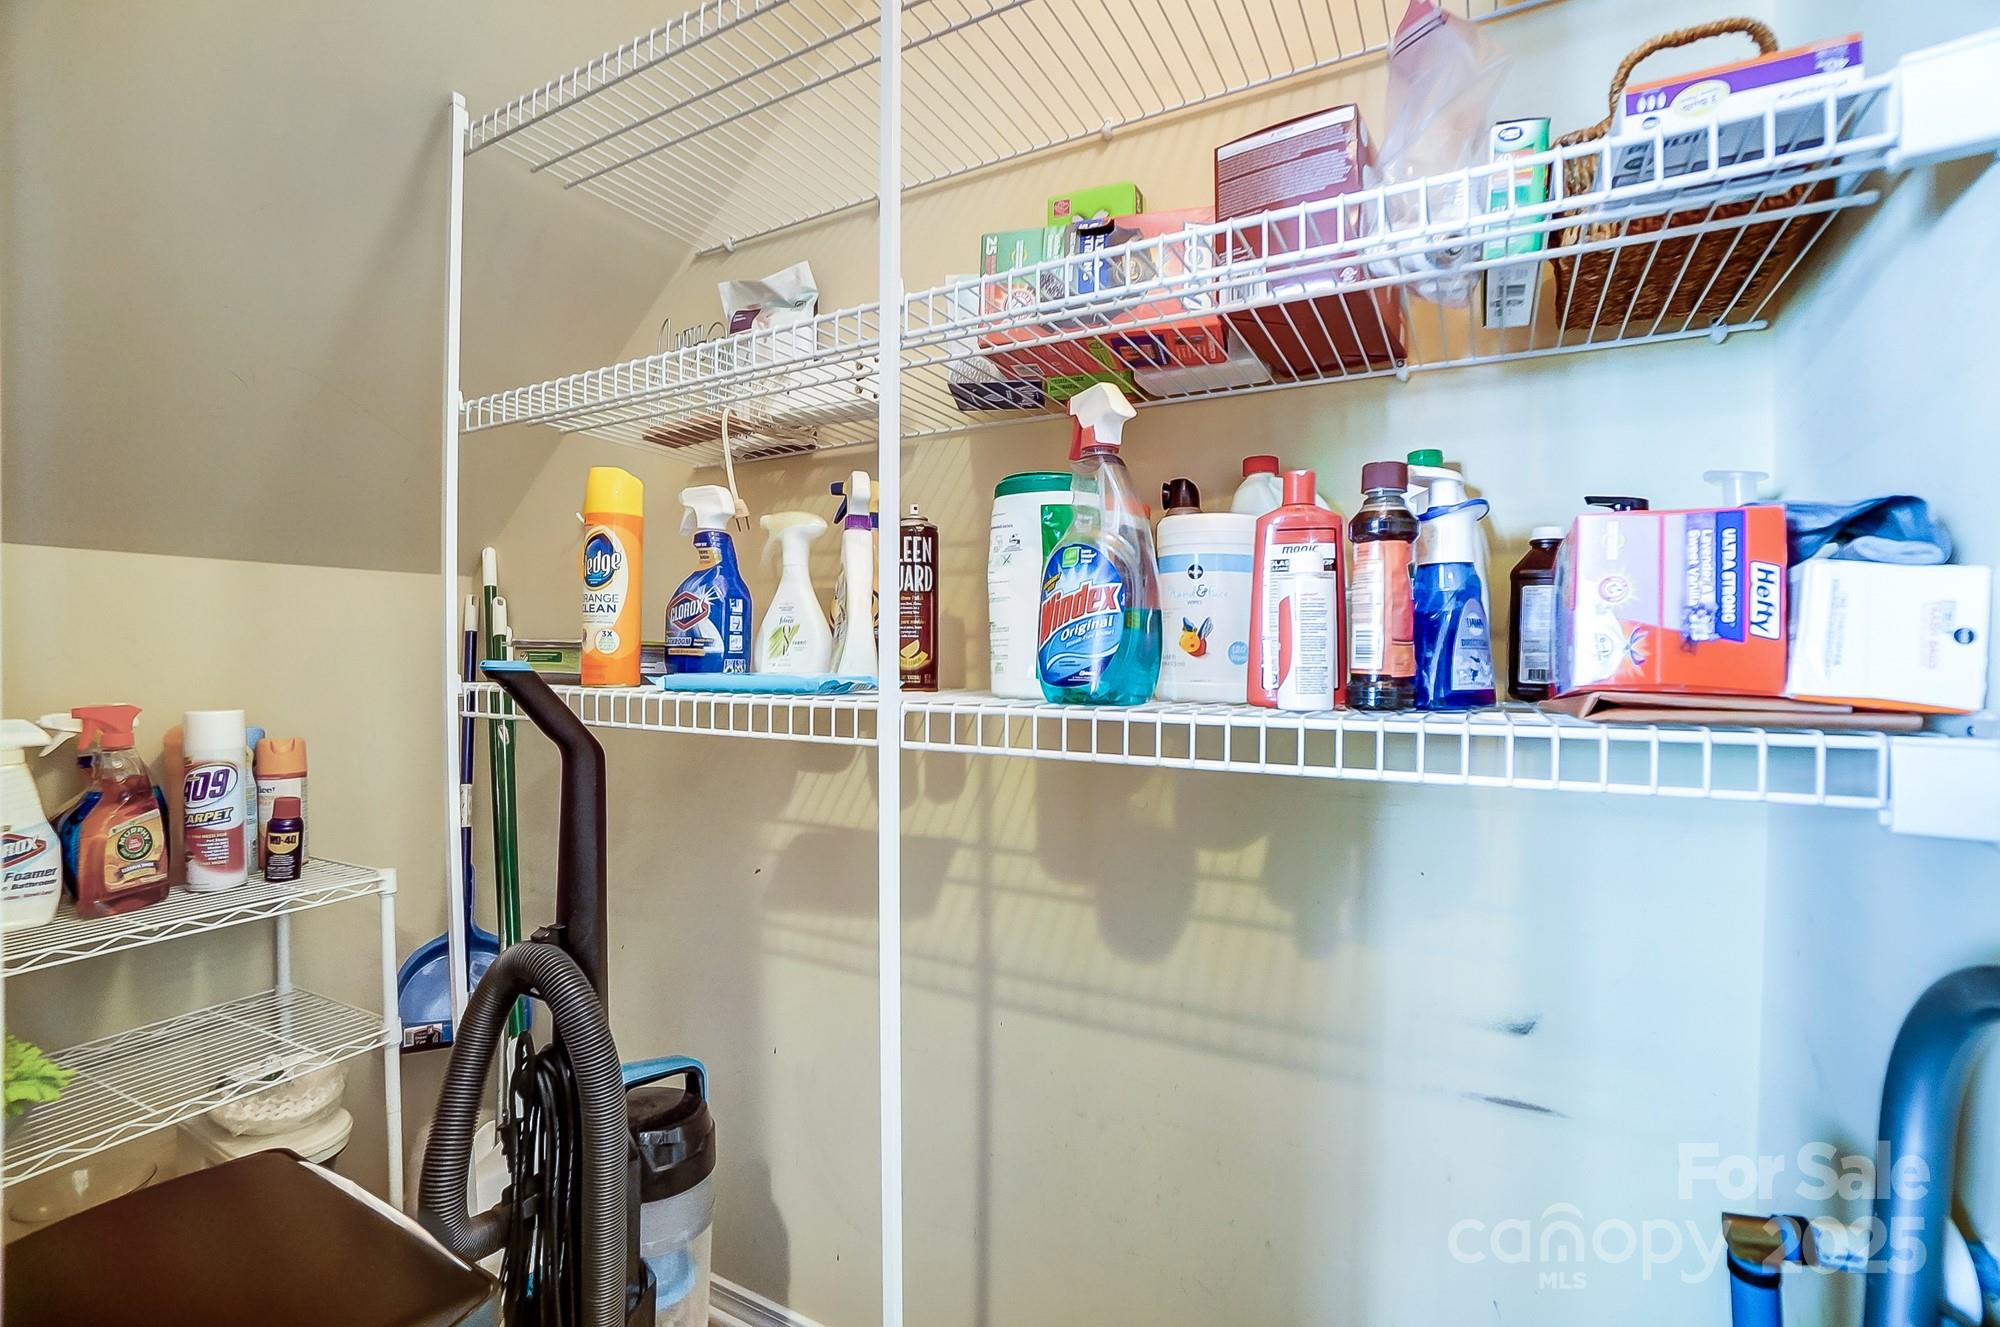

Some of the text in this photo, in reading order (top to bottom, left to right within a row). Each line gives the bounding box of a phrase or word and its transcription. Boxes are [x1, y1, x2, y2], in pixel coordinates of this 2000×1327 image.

[986, 235, 998, 255] 25
[900, 536, 932, 564] EEN
[583, 550, 621, 577] ledge
[900, 565, 933, 592] ARD
[1721, 528, 1737, 623] ULTRA STRONG
[583, 593, 619, 603] RANGE
[1197, 583, 1208, 598] &
[1751, 567, 1776, 633] Hefty
[582, 604, 616, 613] LEAN
[670, 598, 703, 621] CLOROX
[1040, 584, 1118, 643] Windex
[1060, 615, 1114, 641] Original
[184, 807, 233, 825] ARPET
[119, 827, 150, 846] MURPHY
[269, 835, 297, 845] WD-40
[4, 867, 57, 883] Foamer
